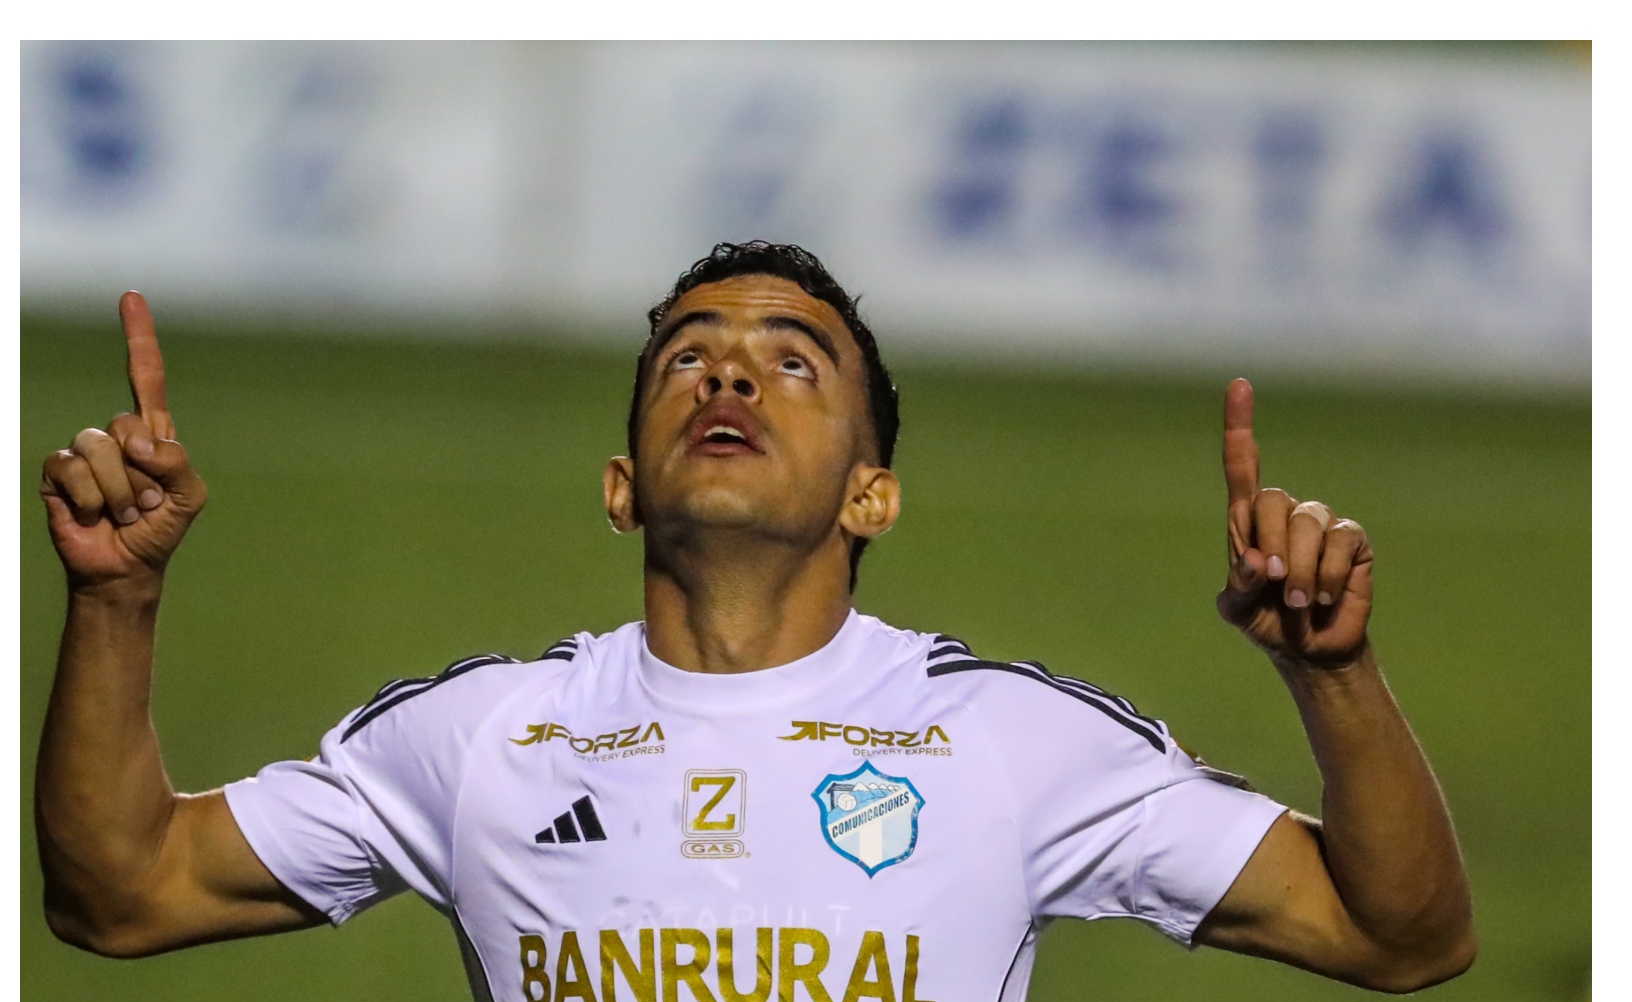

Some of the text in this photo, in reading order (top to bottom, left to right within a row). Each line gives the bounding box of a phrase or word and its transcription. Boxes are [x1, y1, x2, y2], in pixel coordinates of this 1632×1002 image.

[621, 744, 667, 759] EXPRESS
[852, 747, 954, 757] DELIVERY EXPRESS
[689, 775, 737, 832] Z
[830, 790, 911, 839] COMUNICACIONES
[689, 843, 736, 855] GAS
